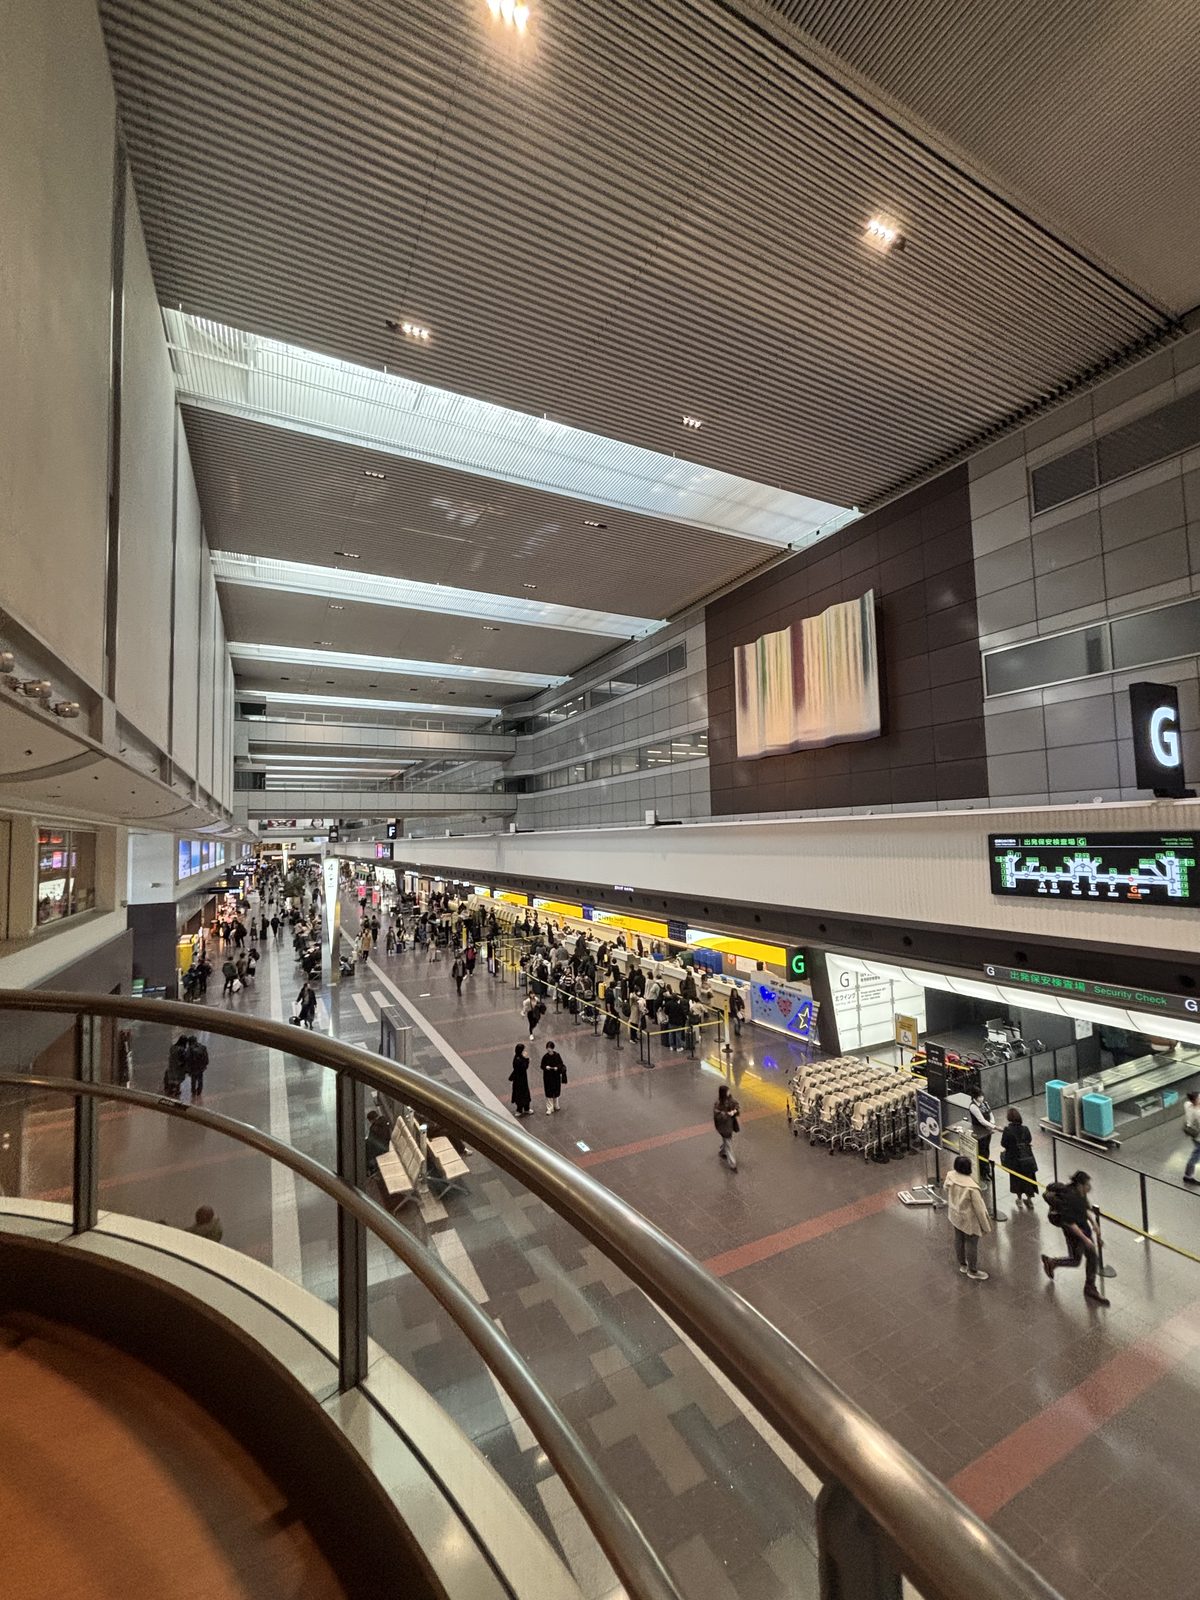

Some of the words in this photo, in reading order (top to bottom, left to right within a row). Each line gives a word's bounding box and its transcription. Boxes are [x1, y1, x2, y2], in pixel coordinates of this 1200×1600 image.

[1150, 706, 1180, 767] G
[388, 826, 396, 837] F
[1130, 885, 1138, 893] G
[791, 954, 805, 974] G
[986, 966, 995, 976] G
[839, 971, 850, 988] G
[1009, 970, 1086, 993] 出発保安検査場
[1093, 985, 1133, 1001] Security
[1135, 992, 1168, 1006] Check
[1184, 999, 1199, 1012] G
